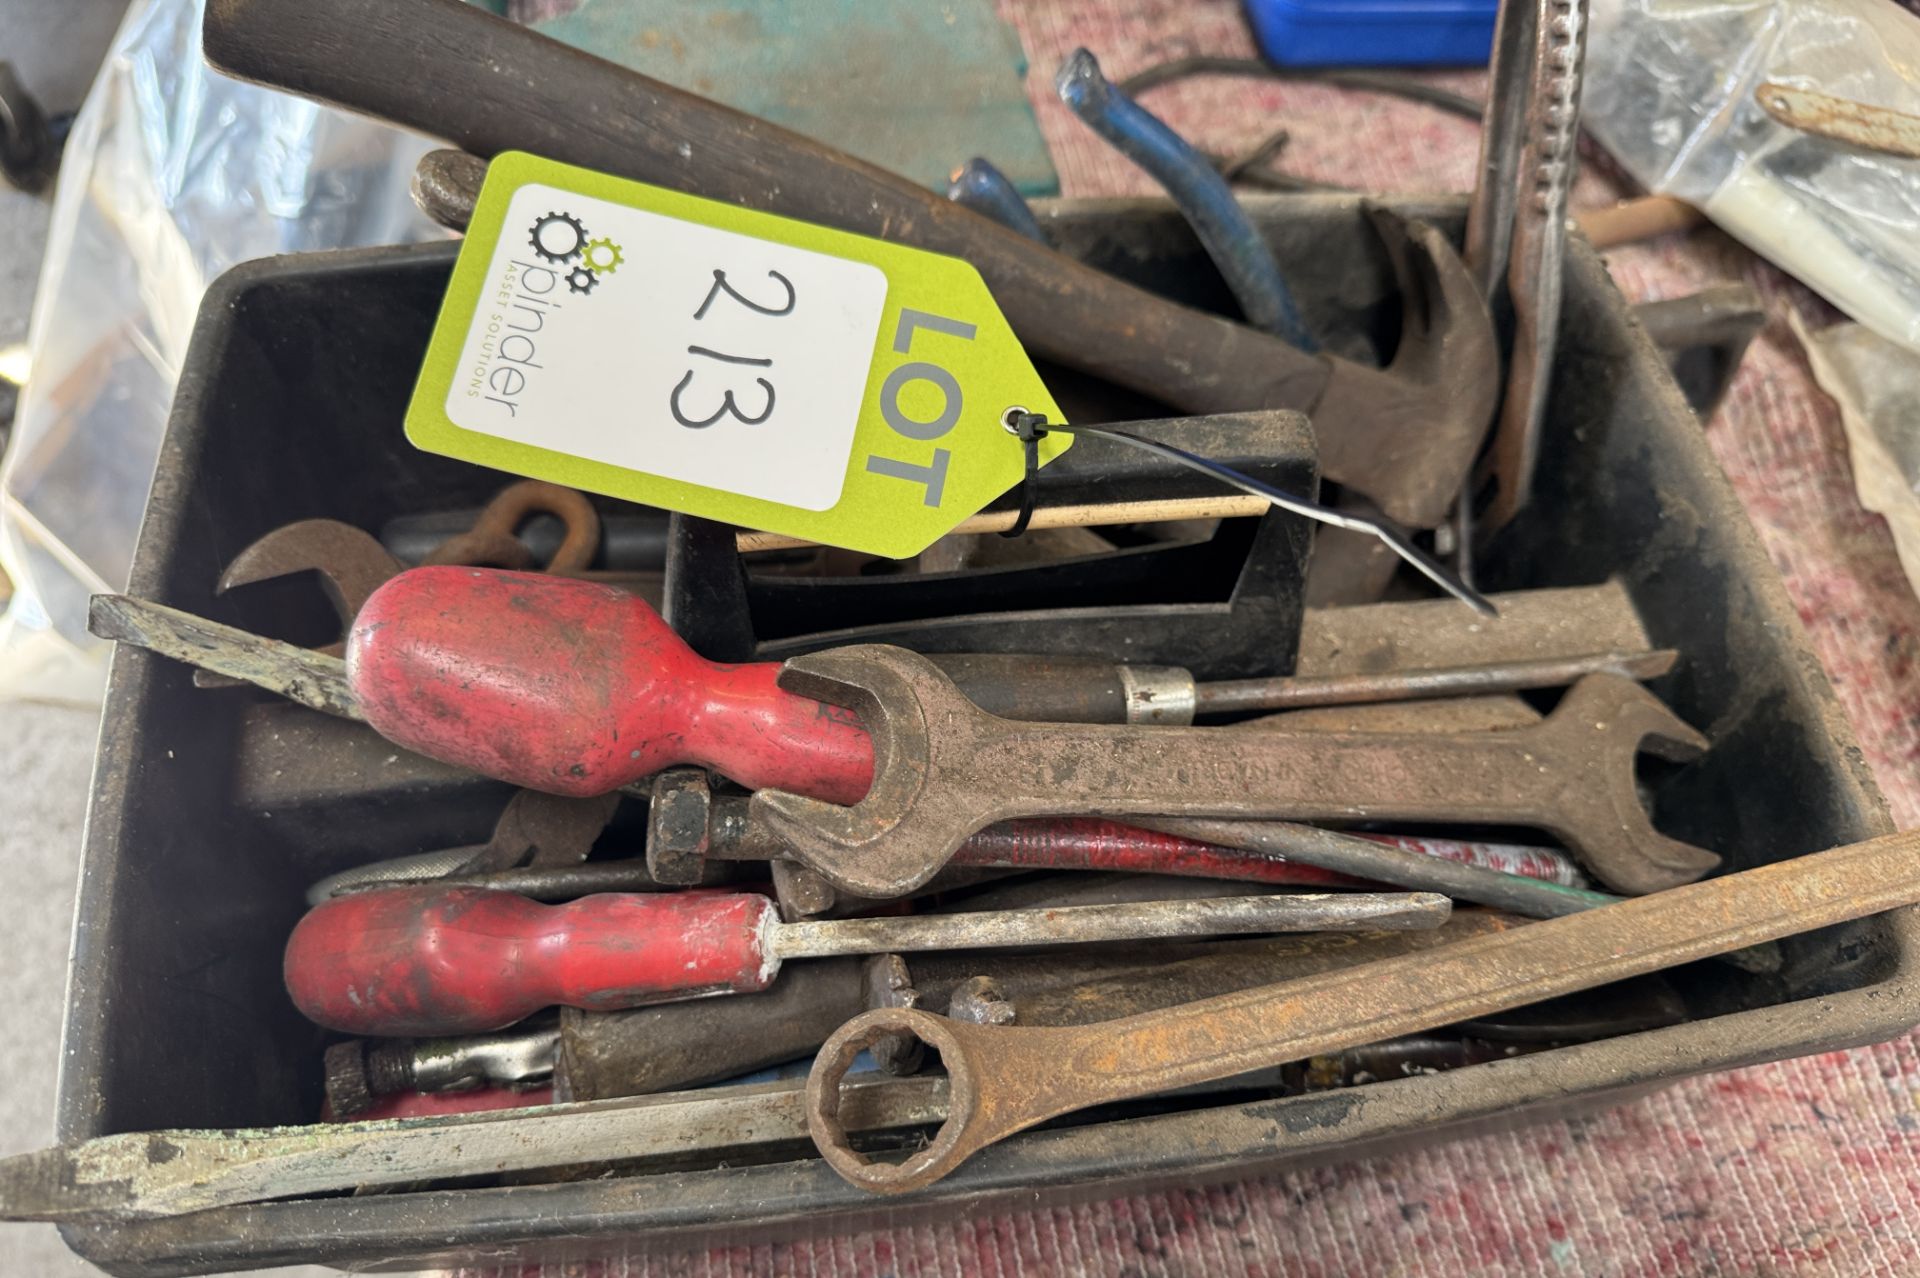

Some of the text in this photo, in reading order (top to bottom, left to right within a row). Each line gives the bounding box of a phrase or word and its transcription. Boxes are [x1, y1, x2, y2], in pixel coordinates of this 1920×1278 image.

[467, 262, 519, 398] ASSET SOLUTIONS
[484, 260, 562, 418] pinder
[670, 269, 796, 429] 213
[867, 308, 977, 508] LOT
